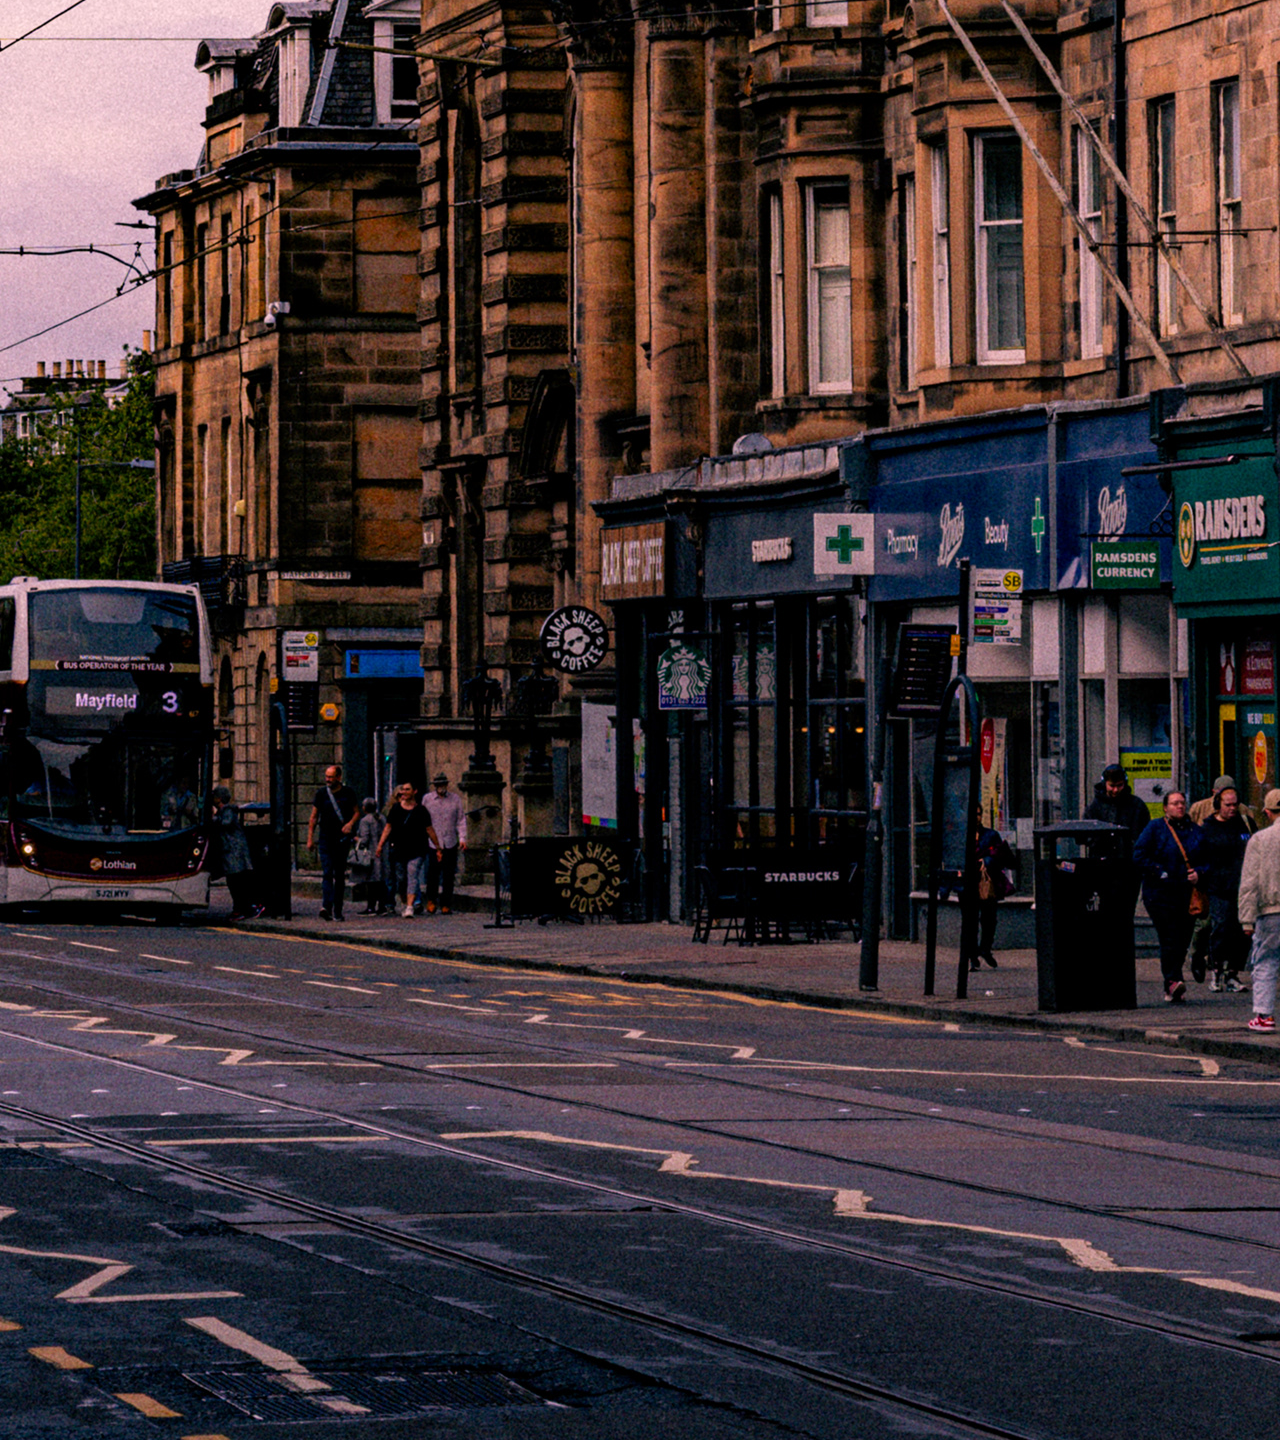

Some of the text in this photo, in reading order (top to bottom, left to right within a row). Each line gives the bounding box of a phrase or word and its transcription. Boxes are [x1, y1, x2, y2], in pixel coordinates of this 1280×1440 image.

[1097, 485, 1128, 542] Boots
[1194, 494, 1266, 541] RAMSDENS
[887, 528, 919, 560] Pharmacy
[937, 501, 965, 568] Boots
[984, 516, 1009, 552] Beauty
[602, 537, 663, 585] BLACK SHEEP COFFEE
[1095, 552, 1157, 563] RAMSDENS
[1004, 574, 1021, 587] SB
[1096, 567, 1155, 578] CURRENCY
[546, 609, 605, 671] BLACK SHEEP COFFEE
[79, 662, 119, 670] OPERATOR
[147, 663, 165, 671] YEAR
[75, 693, 137, 710] Mayfield
[161, 691, 178, 713] 3
[103, 860, 137, 870] Lothian
[555, 841, 621, 914] BLACK SHEEP COFFEE
[764, 871, 839, 882] STARBUCKS
